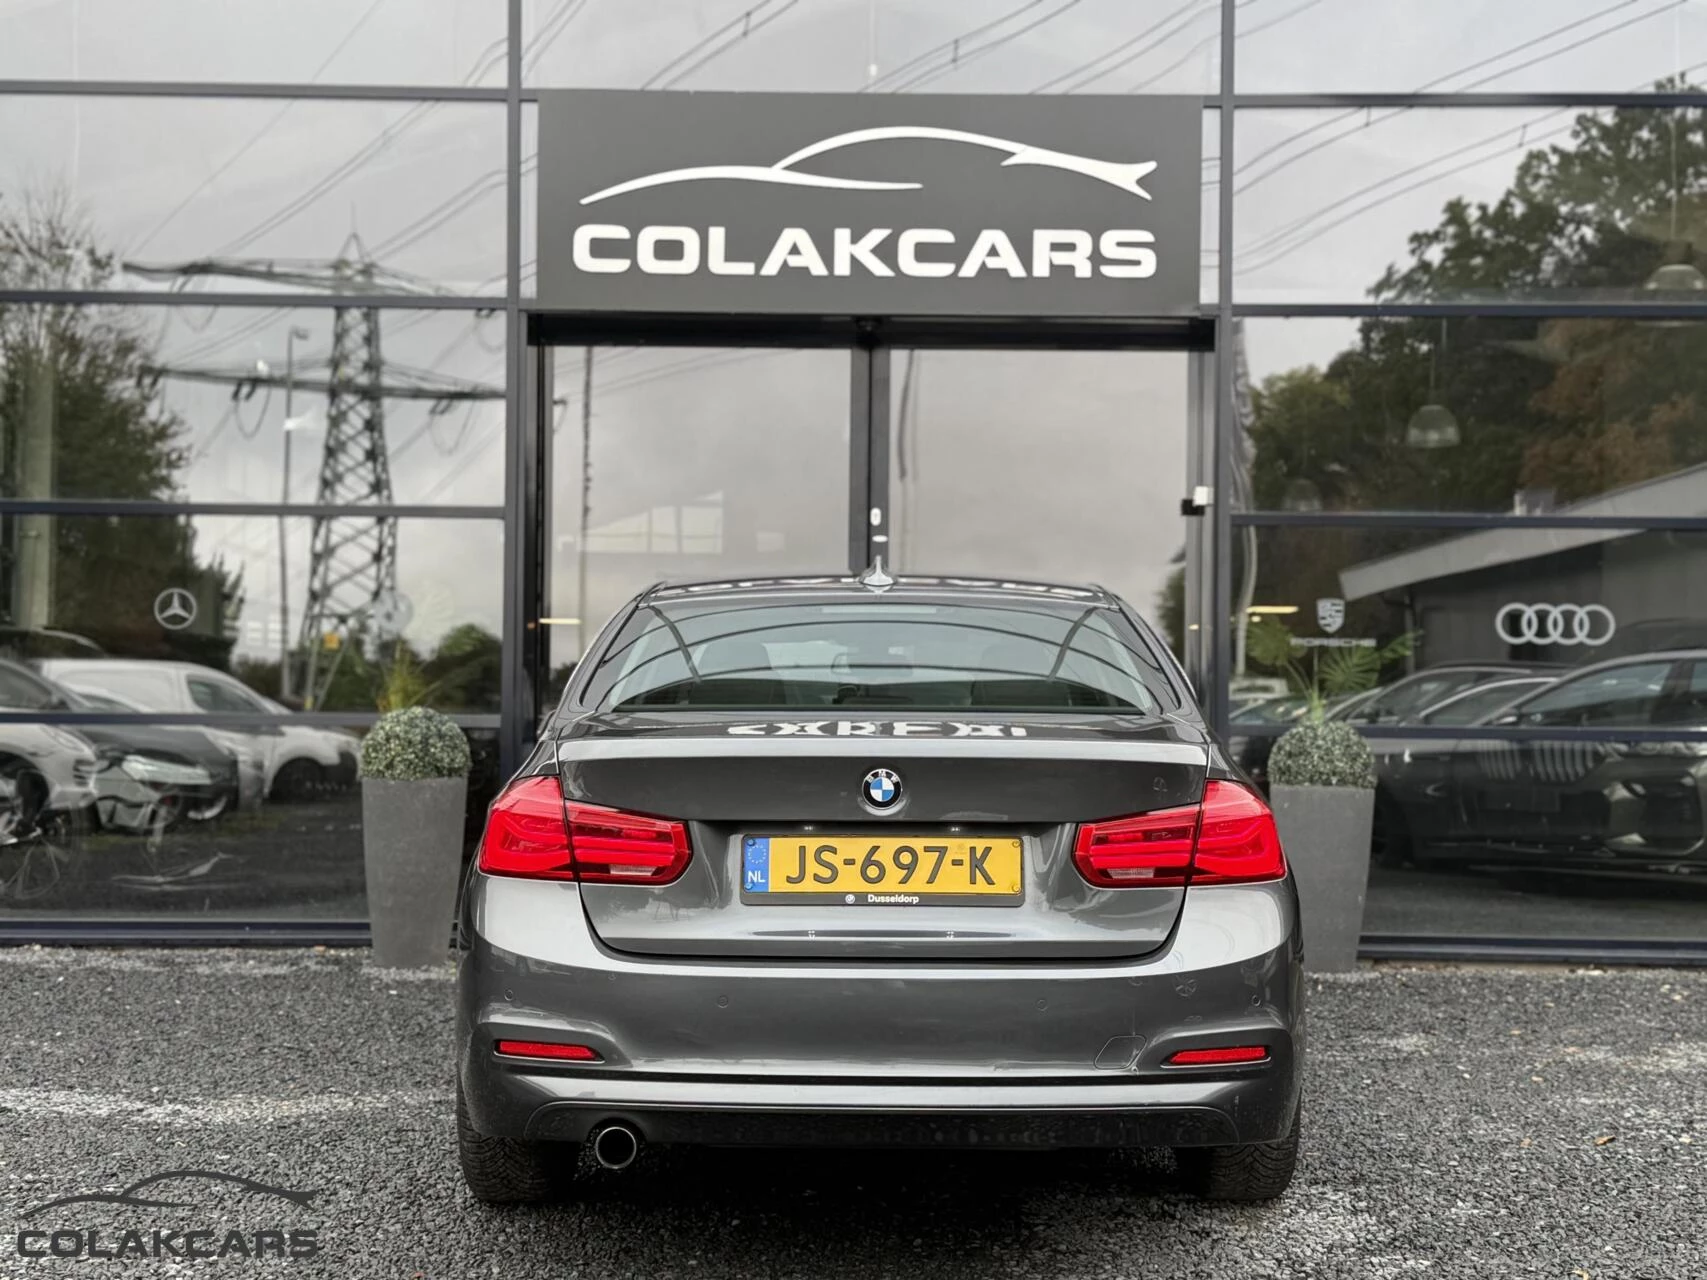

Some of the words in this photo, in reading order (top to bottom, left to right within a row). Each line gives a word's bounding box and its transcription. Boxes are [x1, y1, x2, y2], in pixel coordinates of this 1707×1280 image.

[572, 224, 1157, 278] COLAKCARS
[865, 770, 900, 783] BMW
[785, 844, 996, 886] JS-697-K
[747, 870, 766, 883] NL
[867, 894, 919, 905] Dusseldorp
